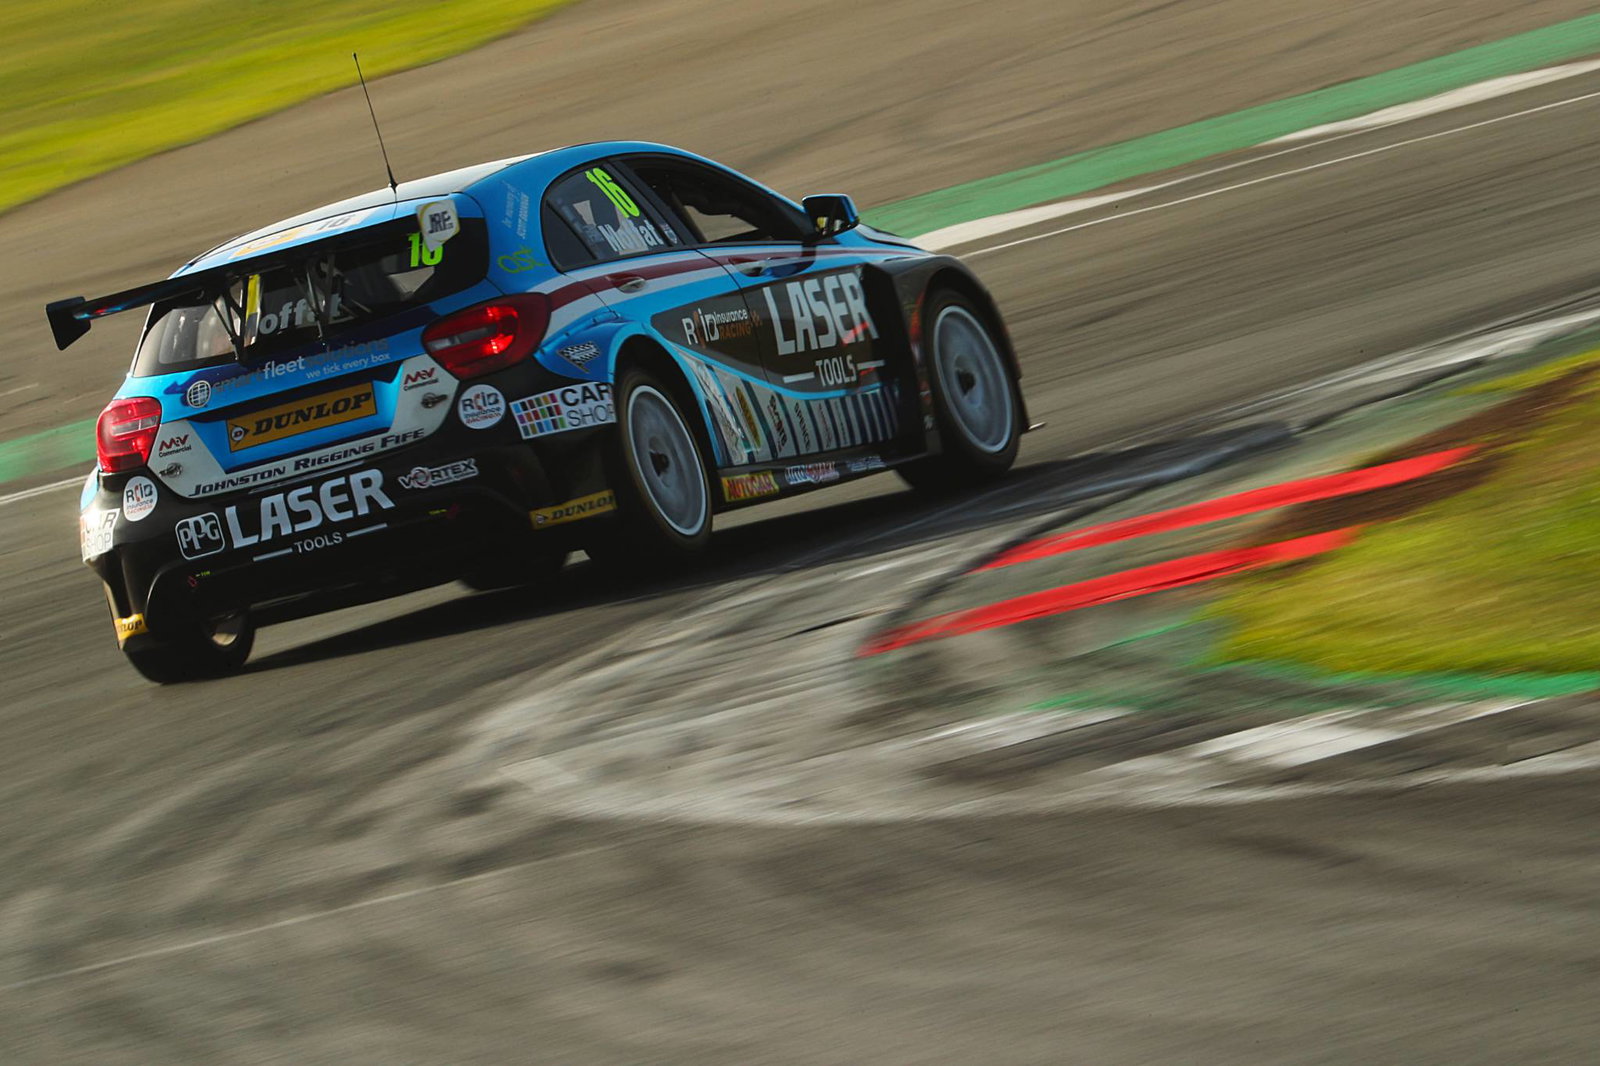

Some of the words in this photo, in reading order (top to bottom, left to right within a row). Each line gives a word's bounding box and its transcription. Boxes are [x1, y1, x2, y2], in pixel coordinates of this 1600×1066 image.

[585, 168, 640, 218] 16
[714, 309, 748, 324] Insurance
[763, 273, 879, 356] LASER
[305, 368, 321, 380] we
[322, 363, 341, 376] tick
[342, 358, 370, 374] every
[370, 351, 391, 365] box
[816, 355, 857, 386] TOOLS
[252, 392, 373, 436] DUNLOP
[188, 466, 286, 497] JOHNSTON
[294, 443, 375, 472] RIGGING
[381, 428, 425, 449] FIFE
[225, 469, 395, 549] LASER
[180, 515, 220, 550] PPG
[294, 532, 343, 554] TOOLS
